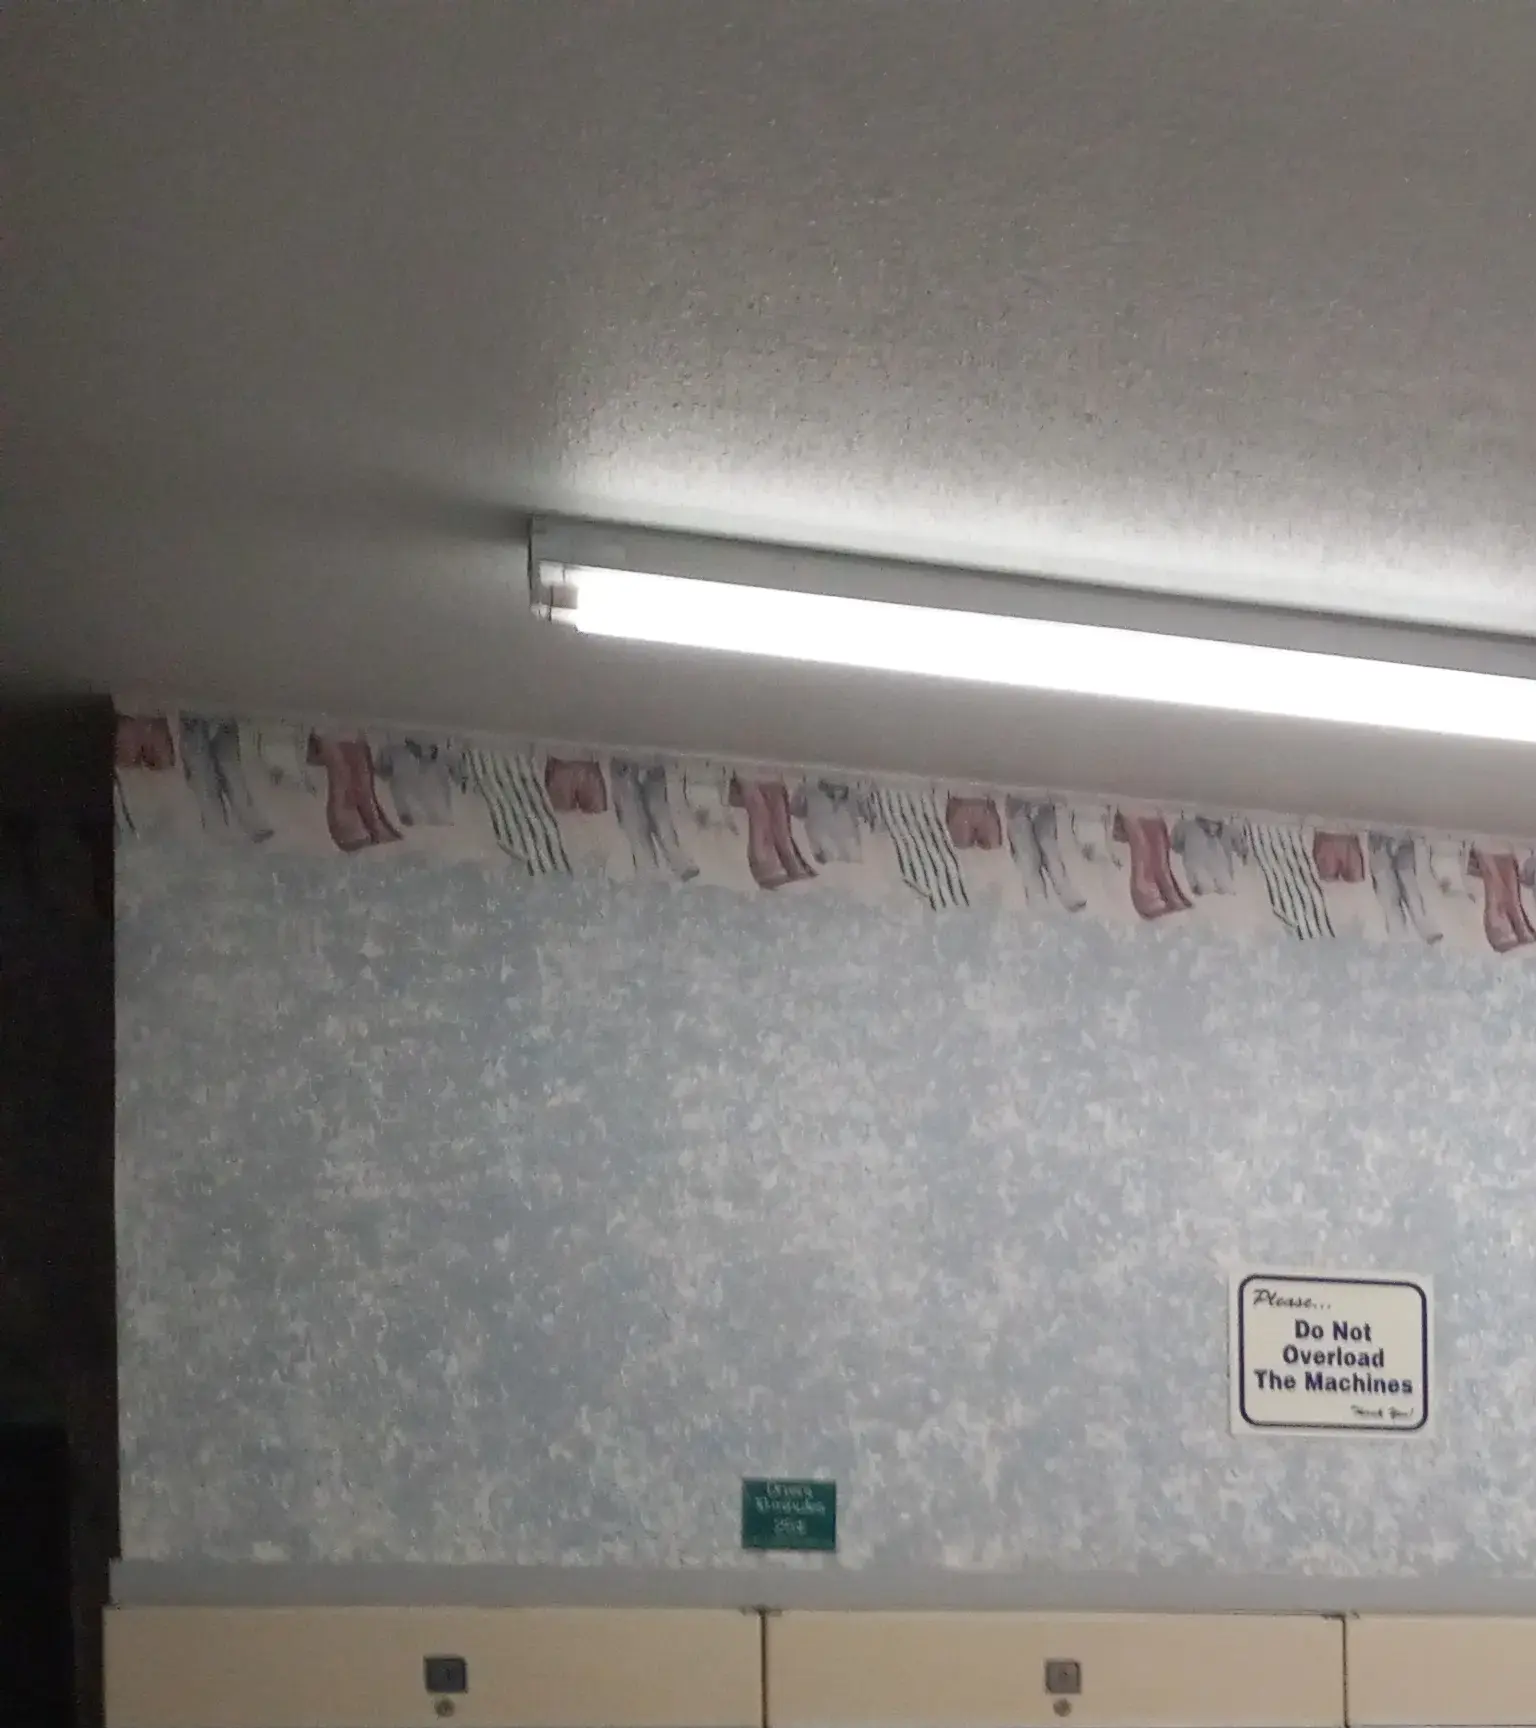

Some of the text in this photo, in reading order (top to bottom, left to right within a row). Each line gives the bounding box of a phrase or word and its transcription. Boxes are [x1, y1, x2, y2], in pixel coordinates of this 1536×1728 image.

[1294, 1318, 1372, 1342] Do Not
[1282, 1344, 1386, 1368] Overload
[1253, 1369, 1414, 1395] The Machines
